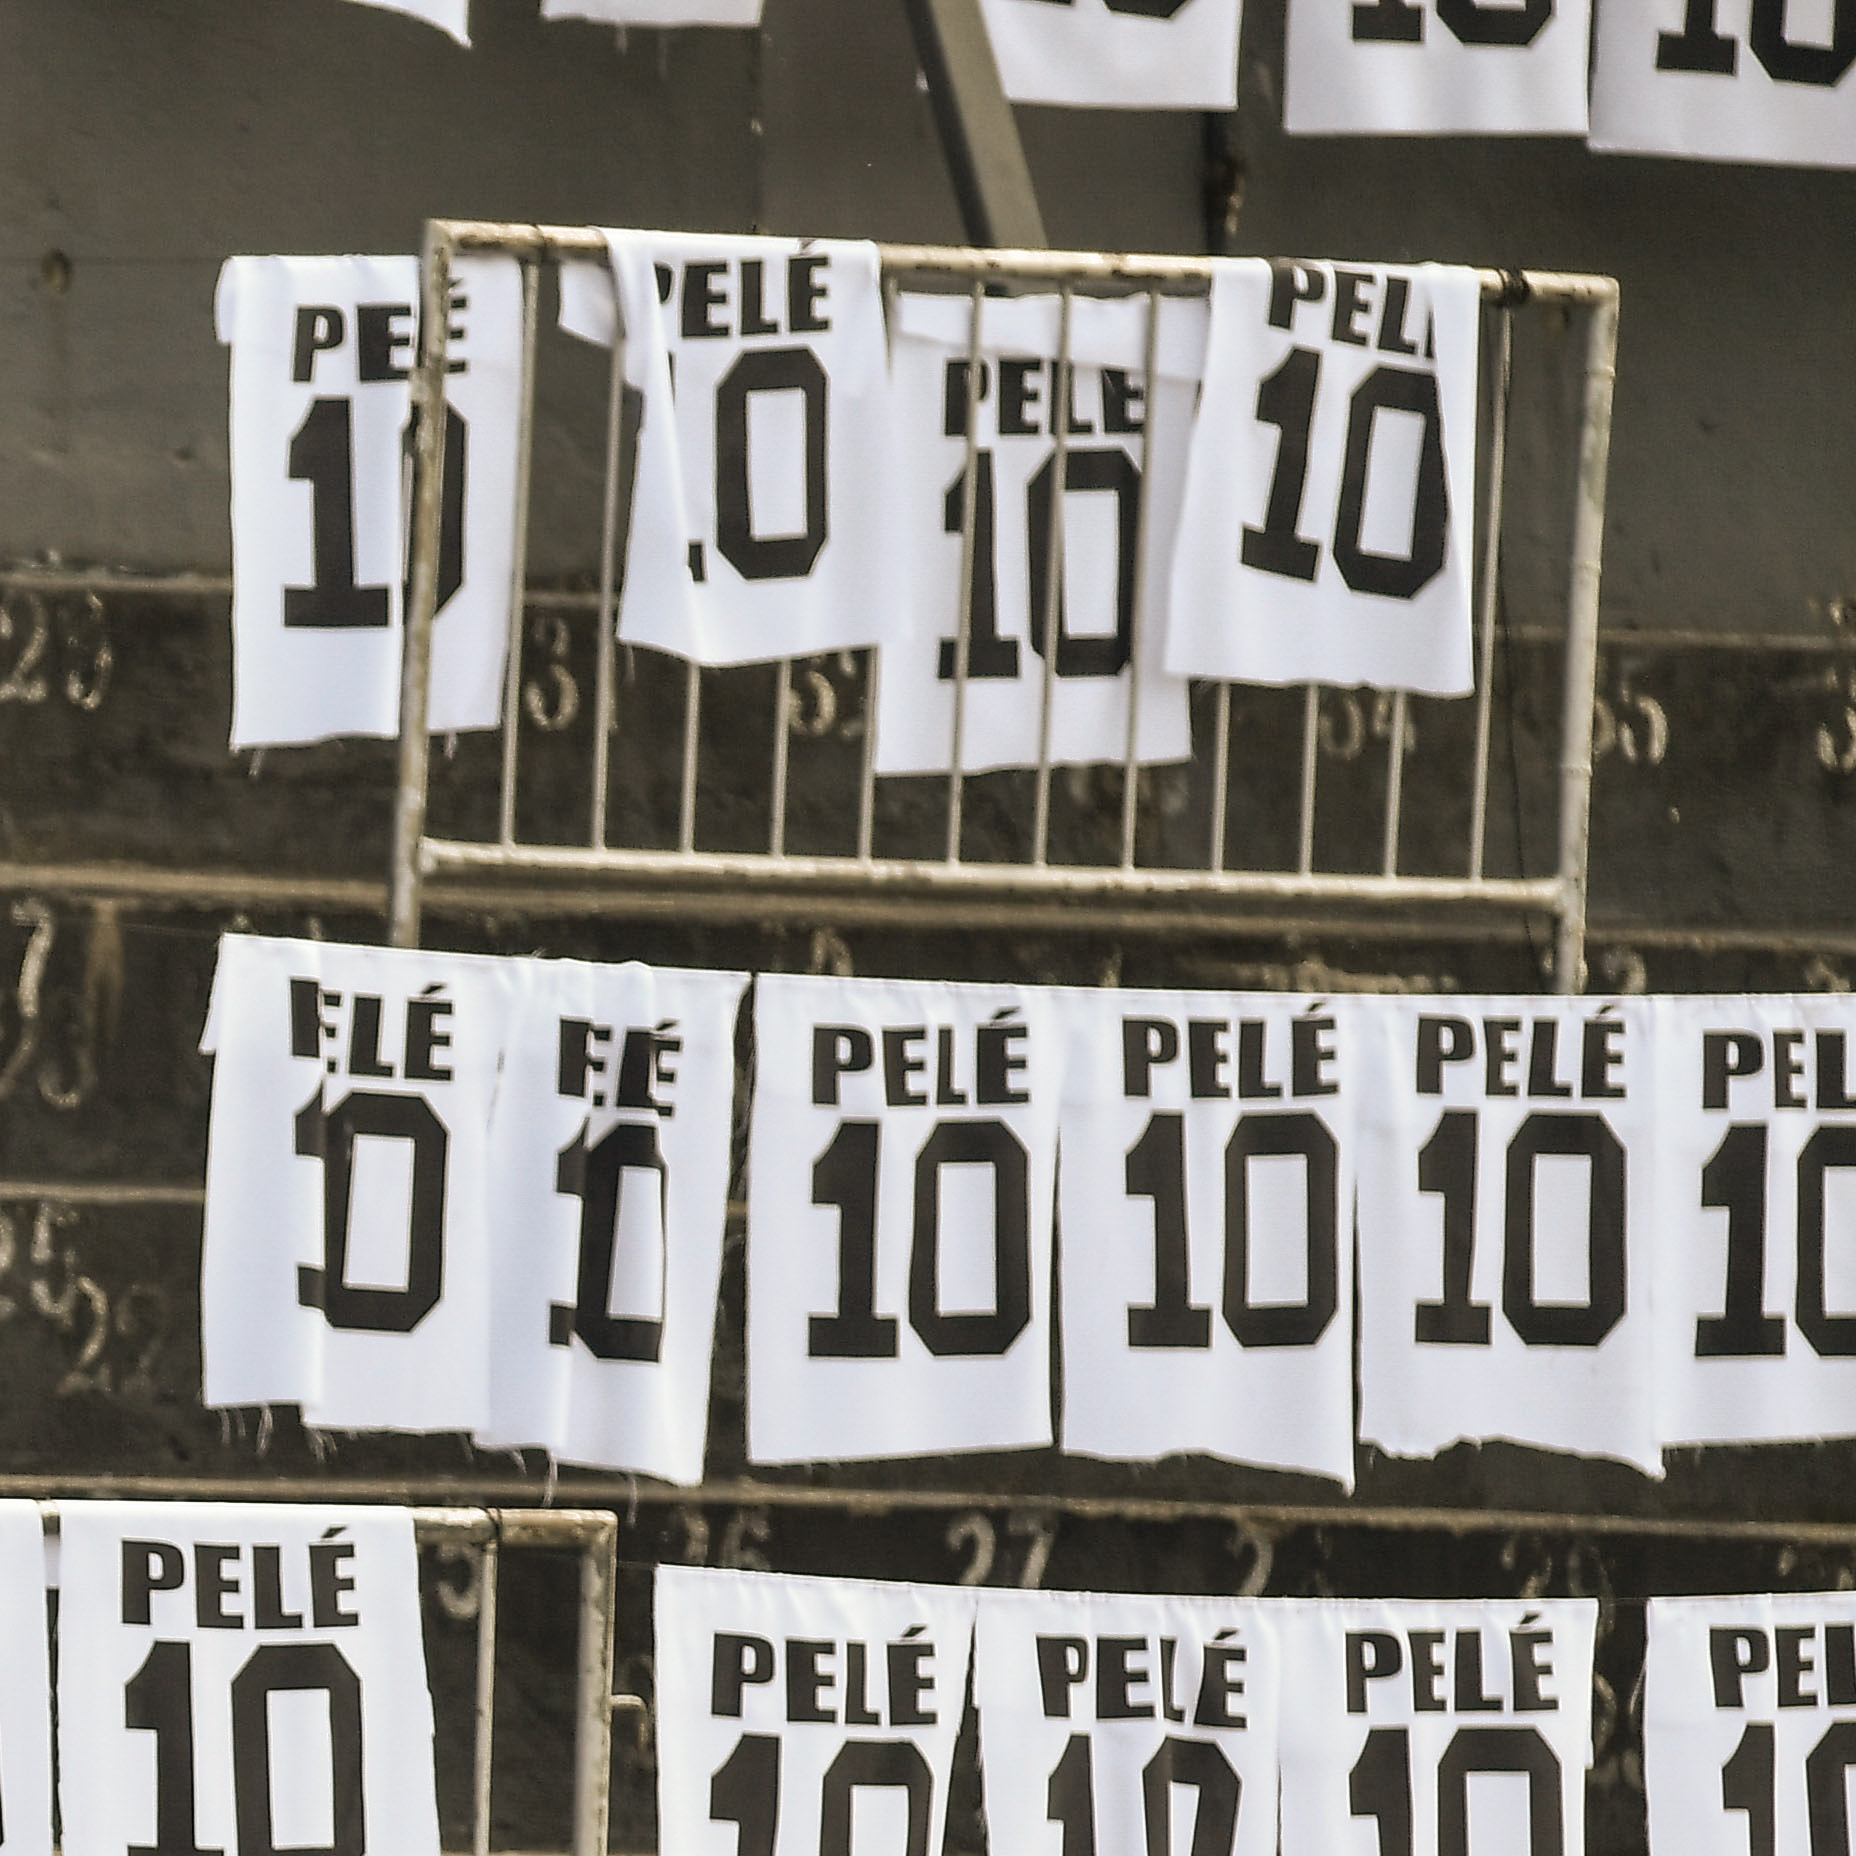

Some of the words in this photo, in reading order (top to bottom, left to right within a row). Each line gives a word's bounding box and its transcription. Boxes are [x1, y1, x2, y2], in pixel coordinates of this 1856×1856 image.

[1266, 260, 1437, 360] PEL
[1239, 343, 1451, 602] 10
[937, 445, 1146, 680] 10
[811, 1008, 1031, 1108] PELÉ
[1121, 1001, 1340, 1100] PELÉ
[1415, 1003, 1627, 1100] PELÉ
[807, 1119, 1032, 1360] 10
[1124, 1111, 1339, 1350] 10
[1413, 1108, 1628, 1348] 10
[1693, 1122, 1856, 1359] 10
[120, 1525, 360, 1631] PELÉ
[710, 1625, 938, 1728] PELÉ
[1034, 1629, 1248, 1730] PELÉ
[1344, 1613, 1560, 1715] PELÉ
